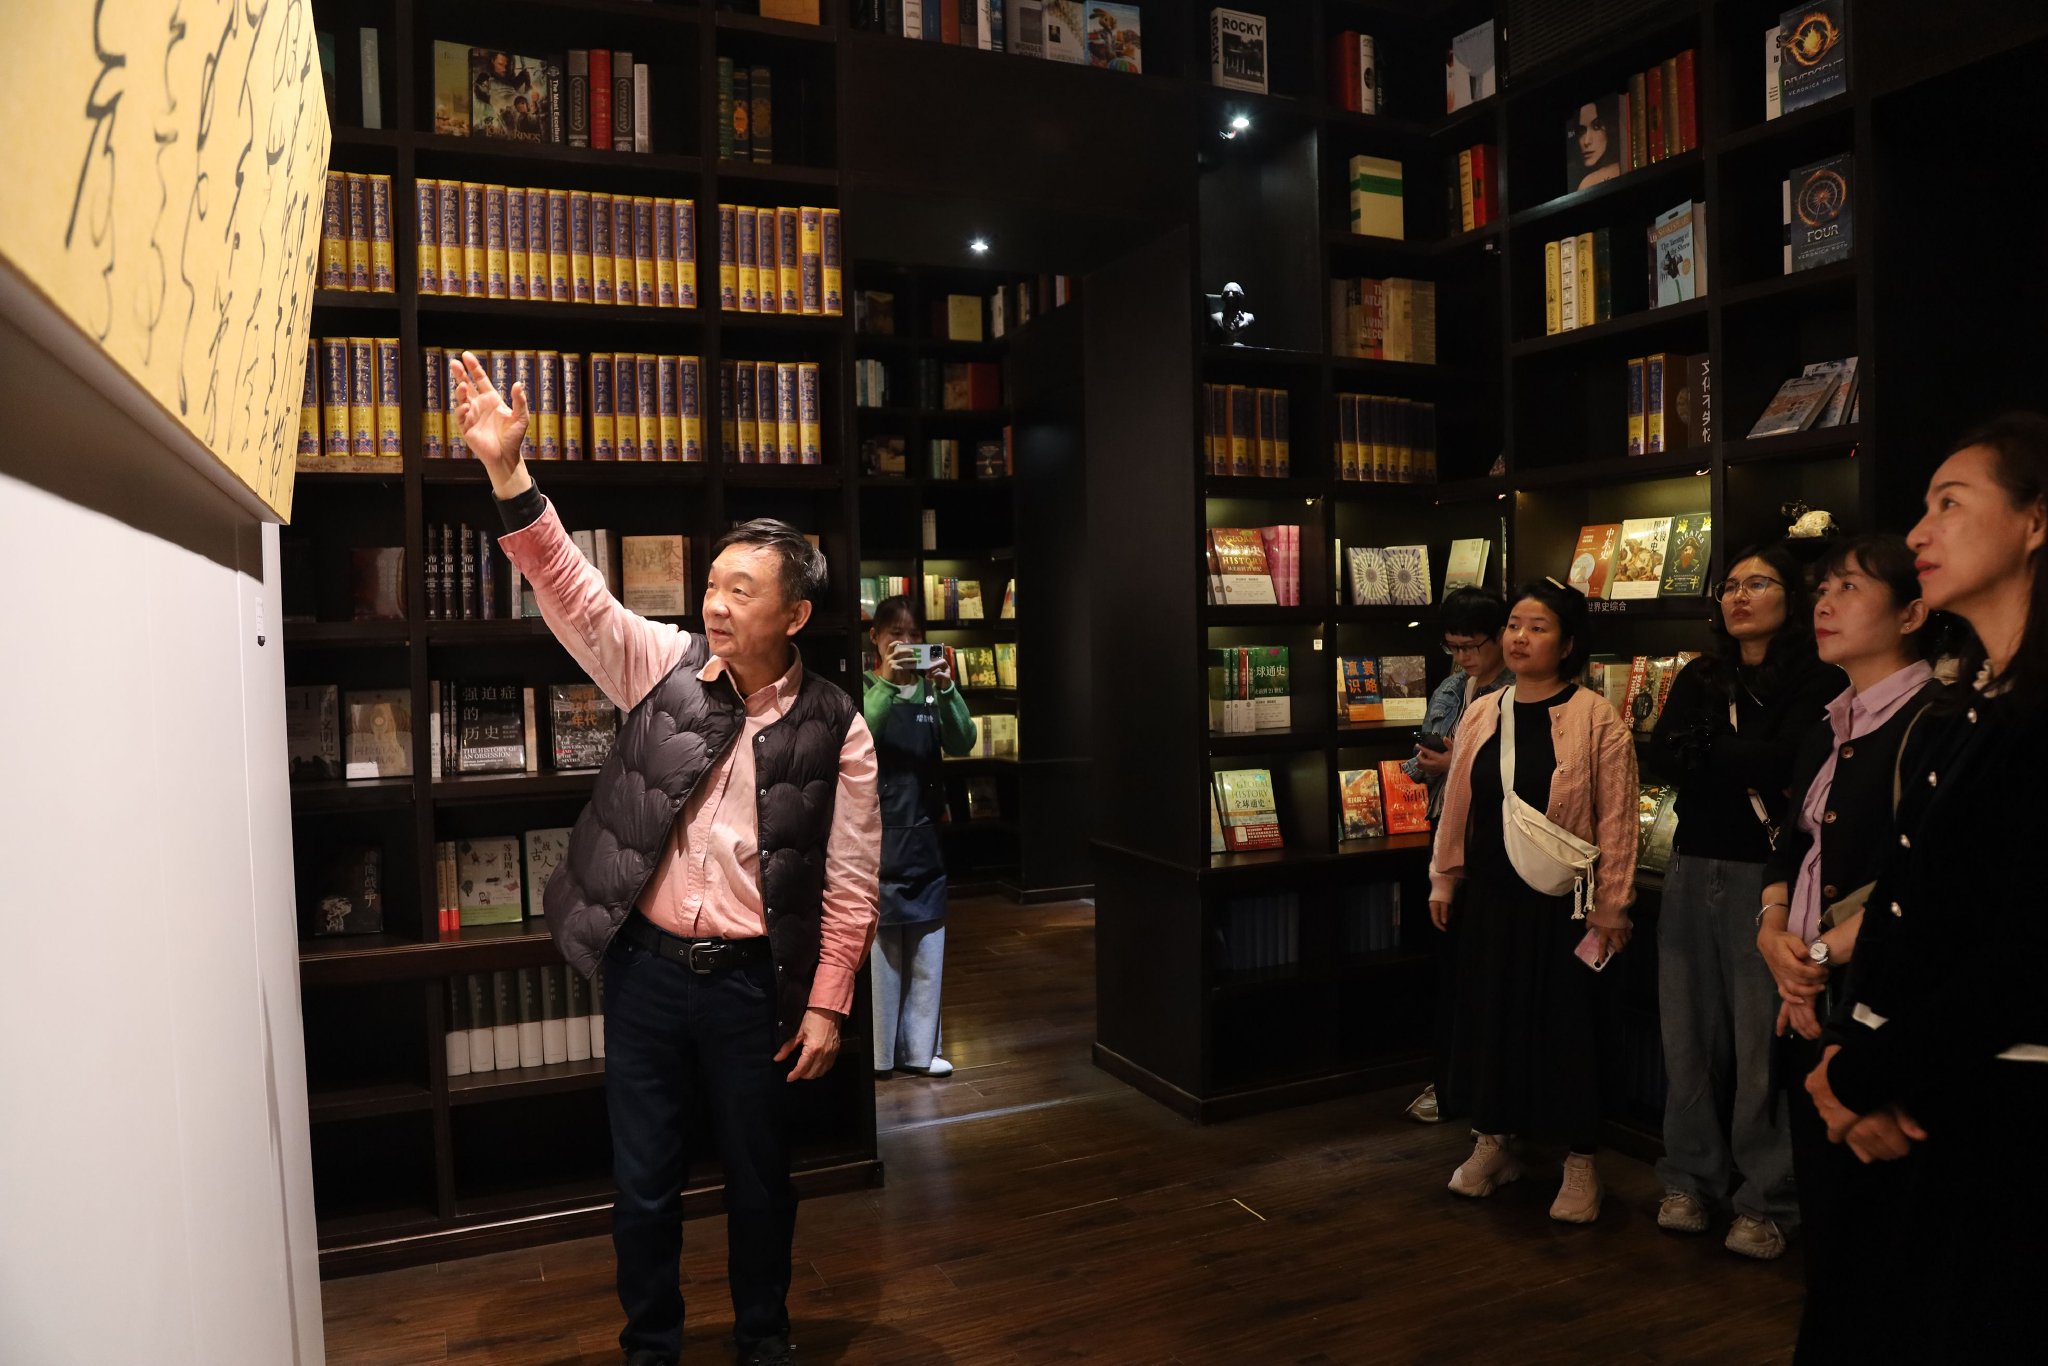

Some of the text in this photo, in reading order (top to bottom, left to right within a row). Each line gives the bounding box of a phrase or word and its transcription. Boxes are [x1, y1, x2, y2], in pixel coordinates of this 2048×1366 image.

[1222, 17, 1263, 36] ROCKY
[1211, 16, 1220, 65] ROCKY
[1784, 58, 1845, 89] DIVERGENT
[1788, 82, 1820, 96] VERONICA
[1823, 74, 1840, 86] ROTH
[1807, 224, 1839, 242] FOUR
[1600, 528, 1615, 560] 中东史
[1677, 530, 1705, 545] PIRATES
[1219, 544, 1262, 556] 全球通史
[1222, 556, 1264, 565] HISTORY
[1664, 577, 1676, 590] 之
[1588, 602, 1627, 612] 世界史综合
[1255, 665, 1286, 678] 球通史
[463, 685, 517, 701] 强迫症
[1627, 675, 1637, 703] THREE
[464, 706, 480, 721] 的
[464, 725, 500, 741] 历史
[474, 751, 511, 759] OBSESSION
[478, 746, 507, 754] HISTORY
[1231, 790, 1268, 800] HISTORY
[1235, 799, 1266, 808] 全球通史
[504, 843, 514, 879] 等待周末
